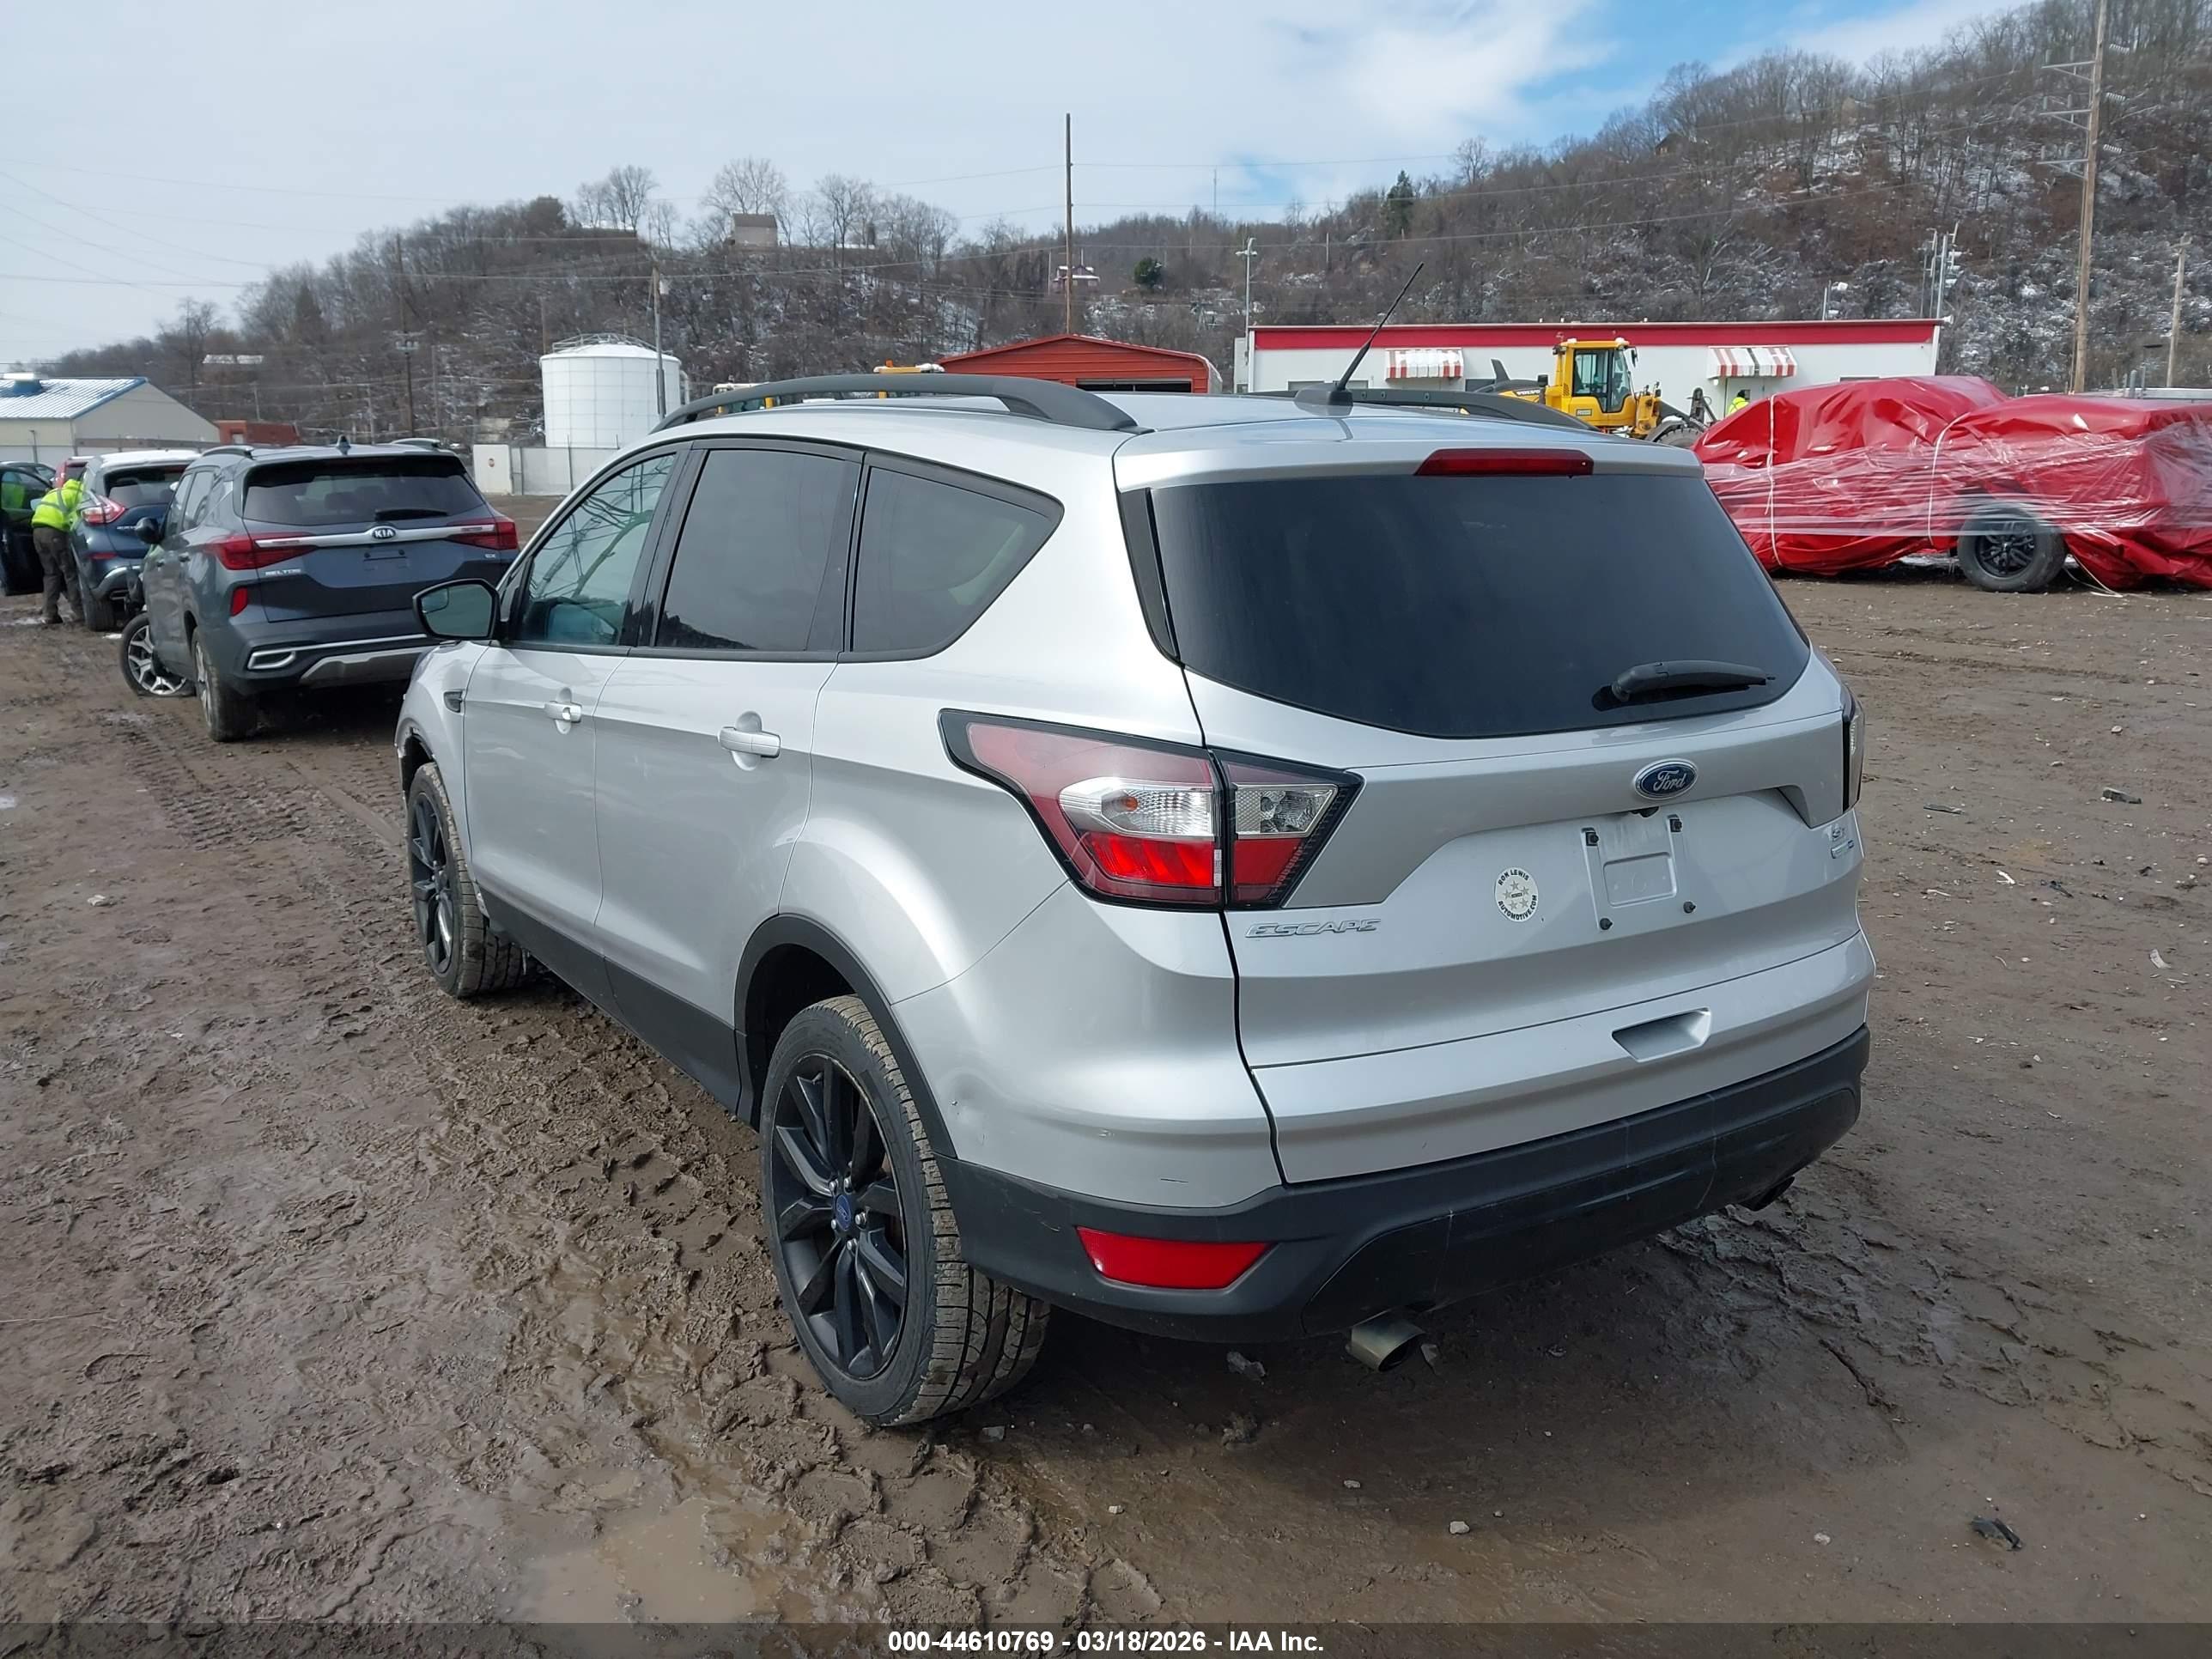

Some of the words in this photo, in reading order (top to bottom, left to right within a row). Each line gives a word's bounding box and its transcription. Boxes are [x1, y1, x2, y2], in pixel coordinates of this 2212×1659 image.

[374, 529, 394, 538] KIA
[1653, 770, 1686, 792] Ford
[1498, 871, 1510, 886] RON
[1510, 869, 1529, 881] LEWIS
[1498, 895, 1537, 921] AUTOMOTIVE.COM
[1245, 918, 1382, 938] ESCAPE
